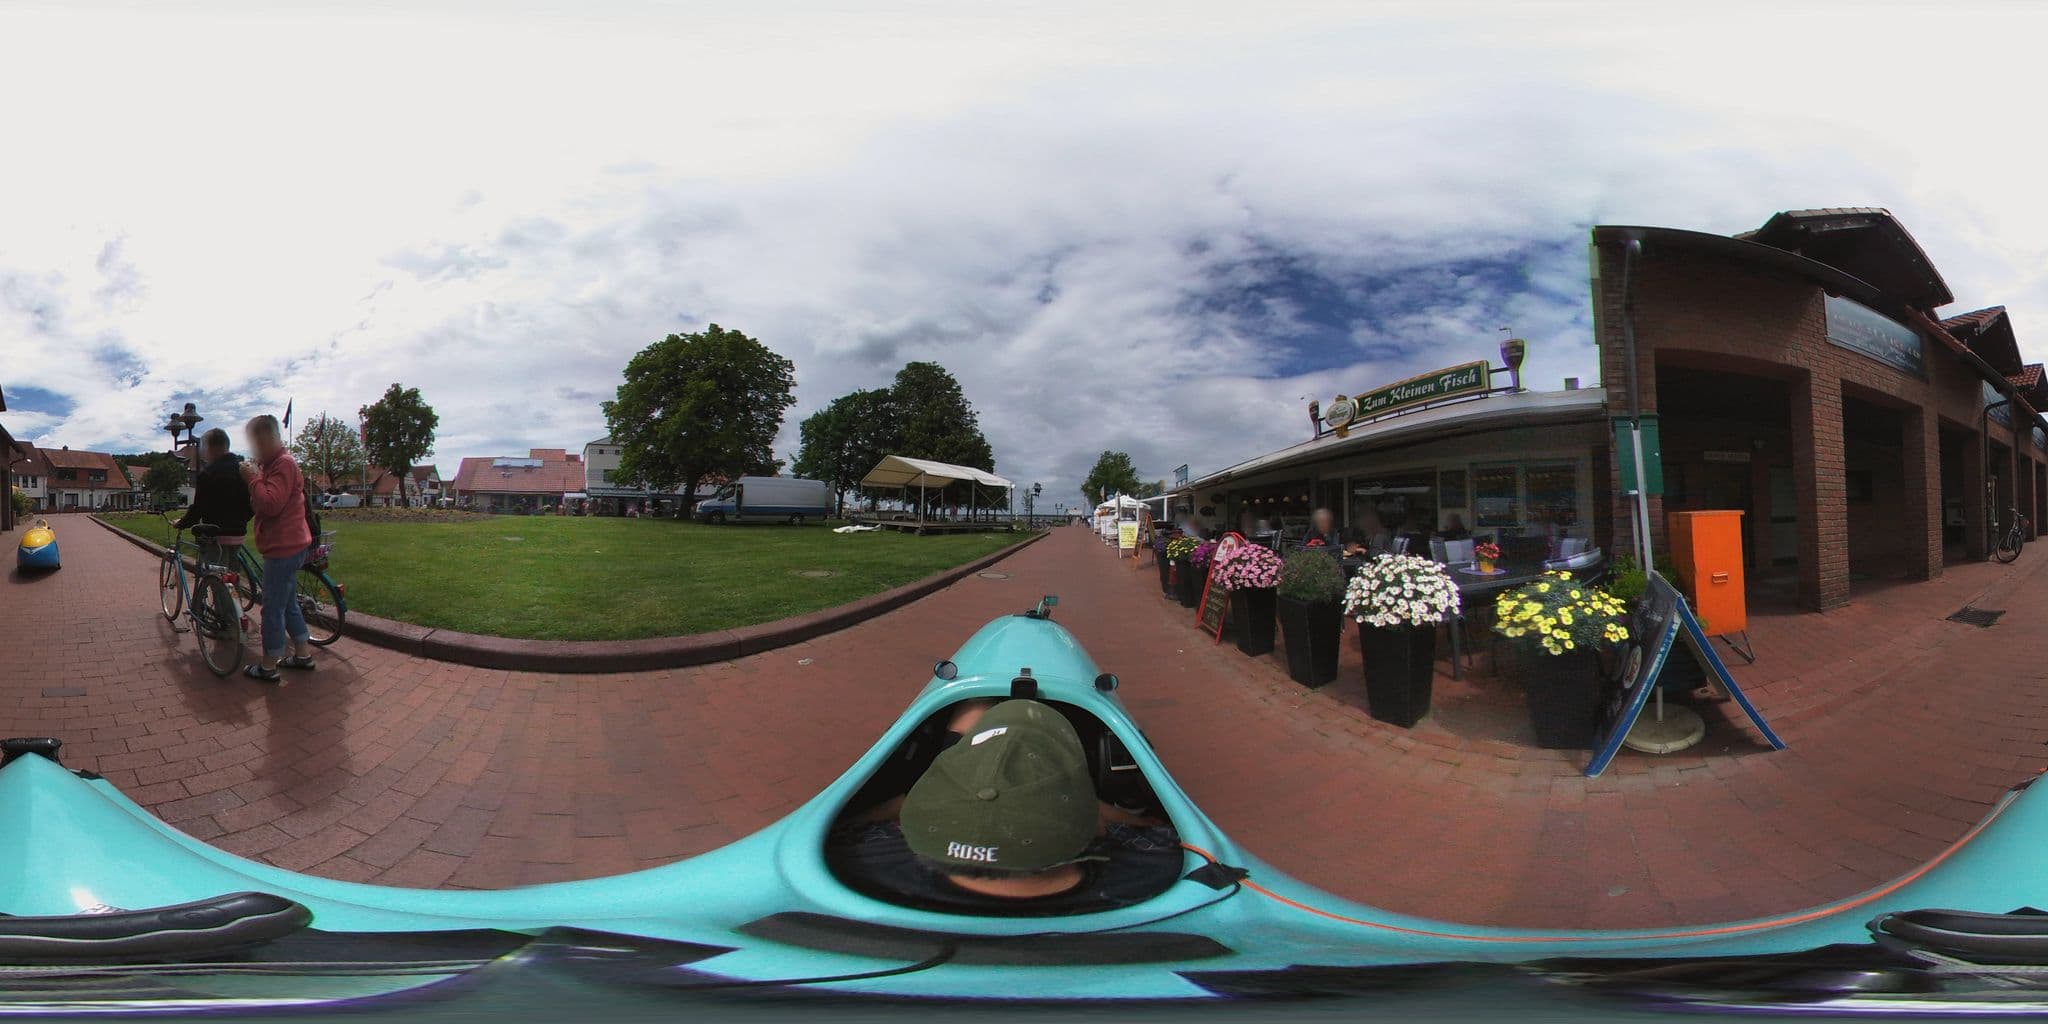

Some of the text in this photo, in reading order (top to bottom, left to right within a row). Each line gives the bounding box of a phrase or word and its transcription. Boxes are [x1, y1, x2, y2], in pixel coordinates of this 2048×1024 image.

[1364, 368, 1476, 410] Zum Kleinen Fisch
[947, 841, 999, 862] ROSE
